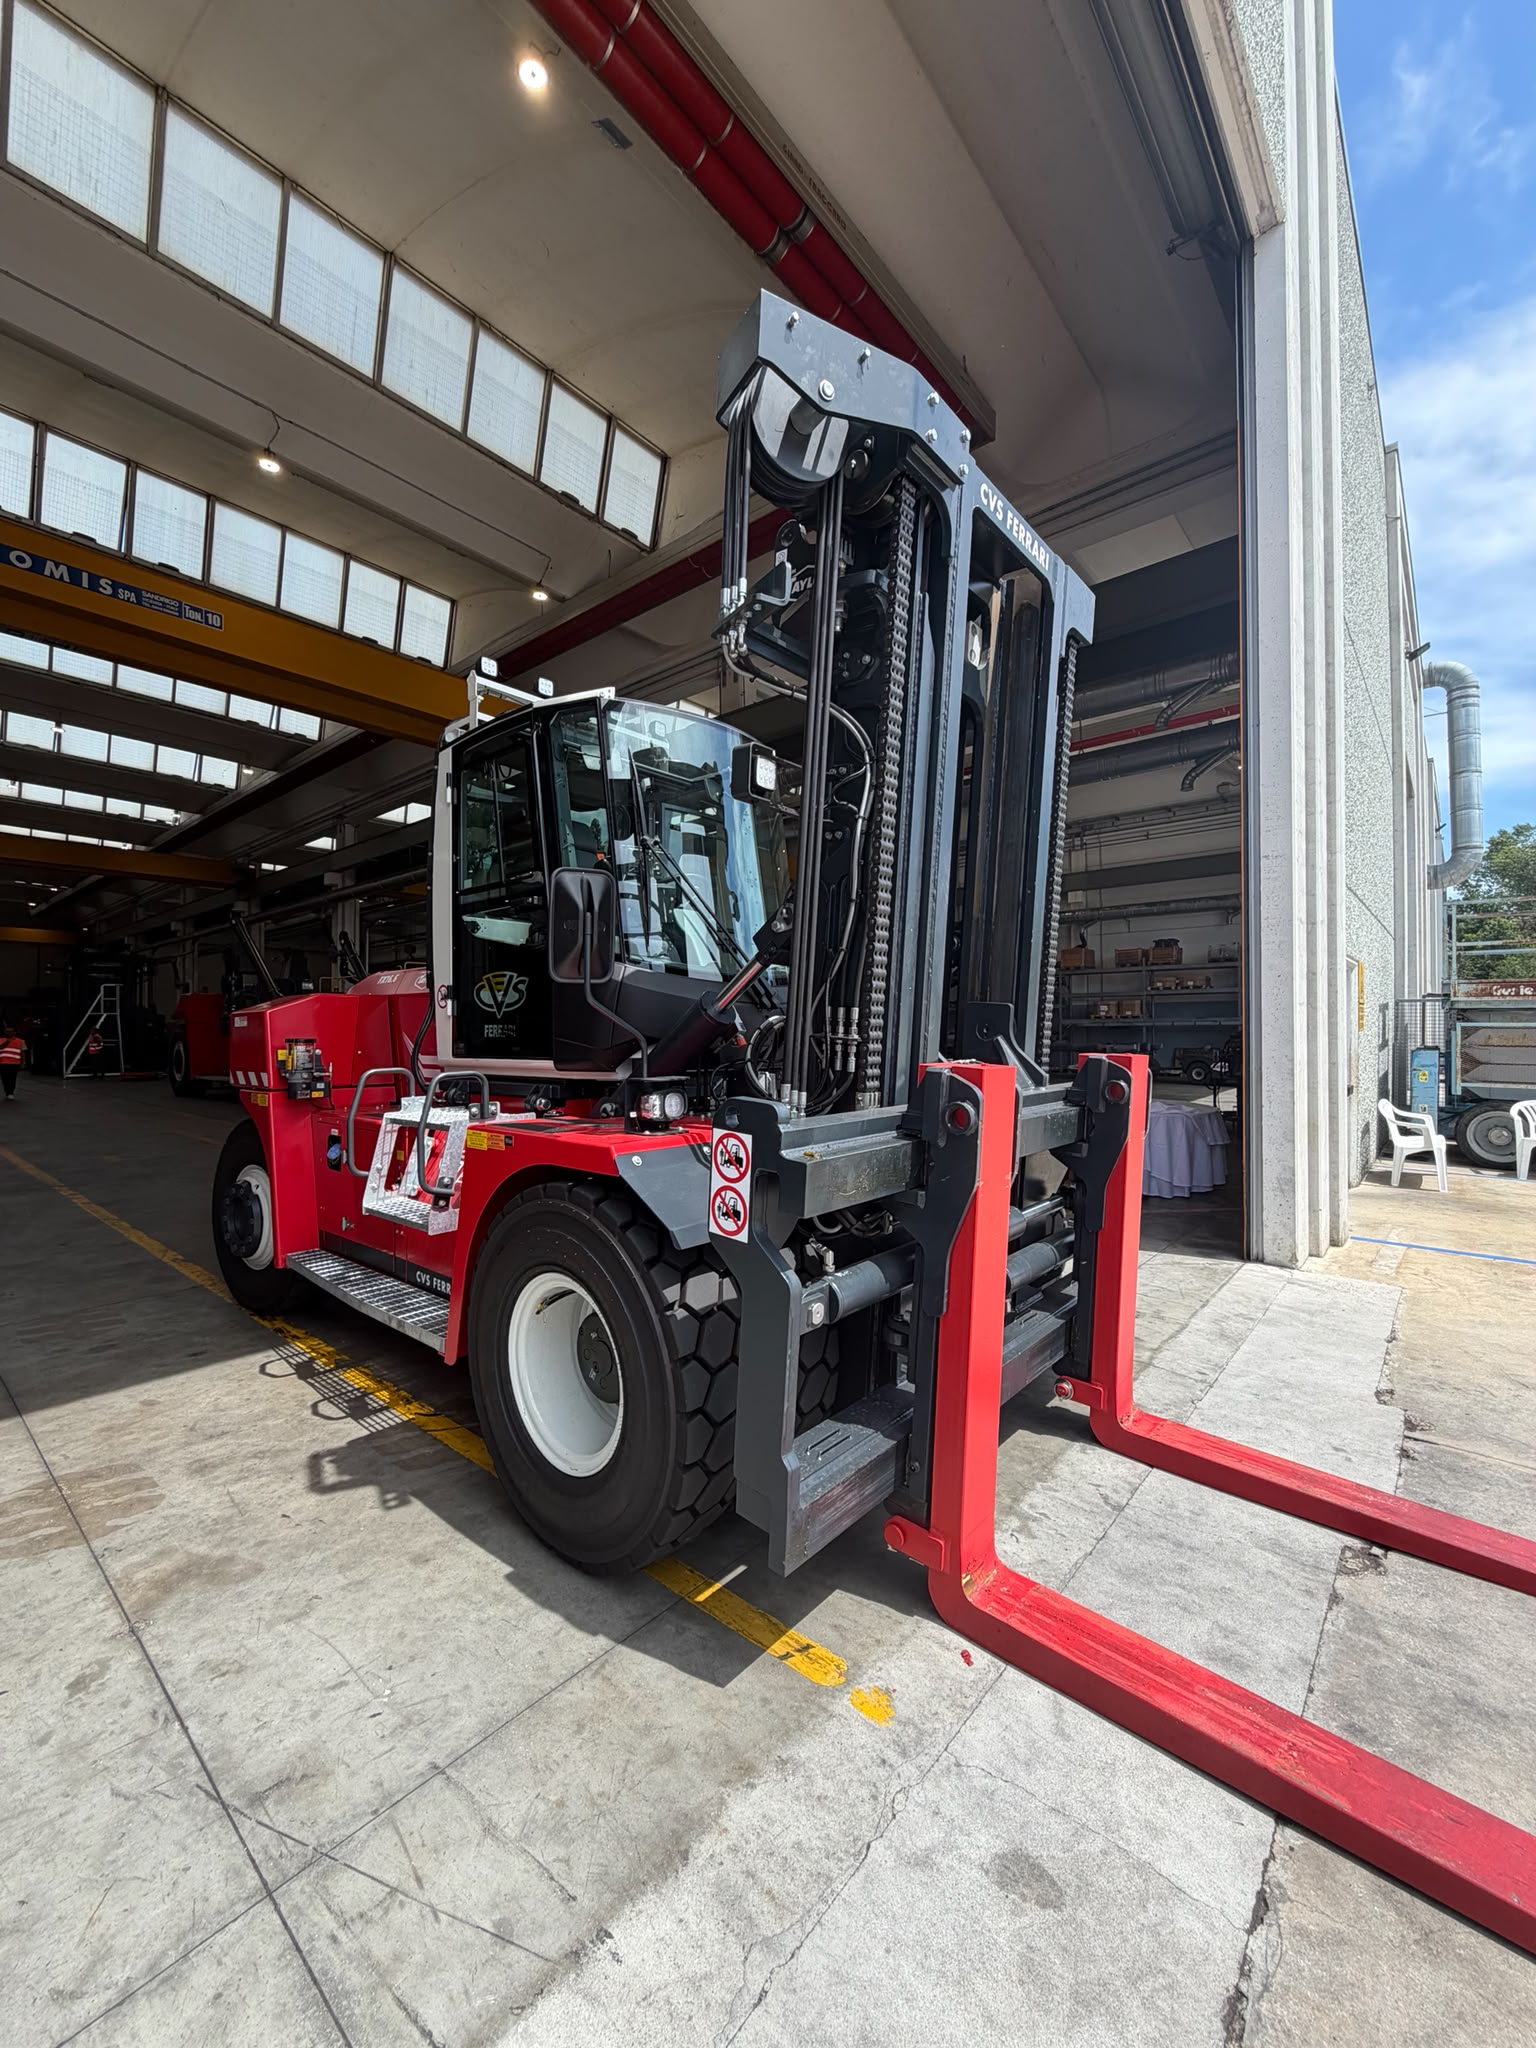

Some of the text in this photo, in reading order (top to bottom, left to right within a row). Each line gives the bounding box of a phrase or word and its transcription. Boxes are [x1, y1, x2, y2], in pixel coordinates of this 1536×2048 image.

[980, 483, 1050, 571] CVS FERRARI
[8, 550, 138, 604] OMIS SPA
[206, 612, 221, 627] 10
[415, 1270, 431, 1287] CVS
